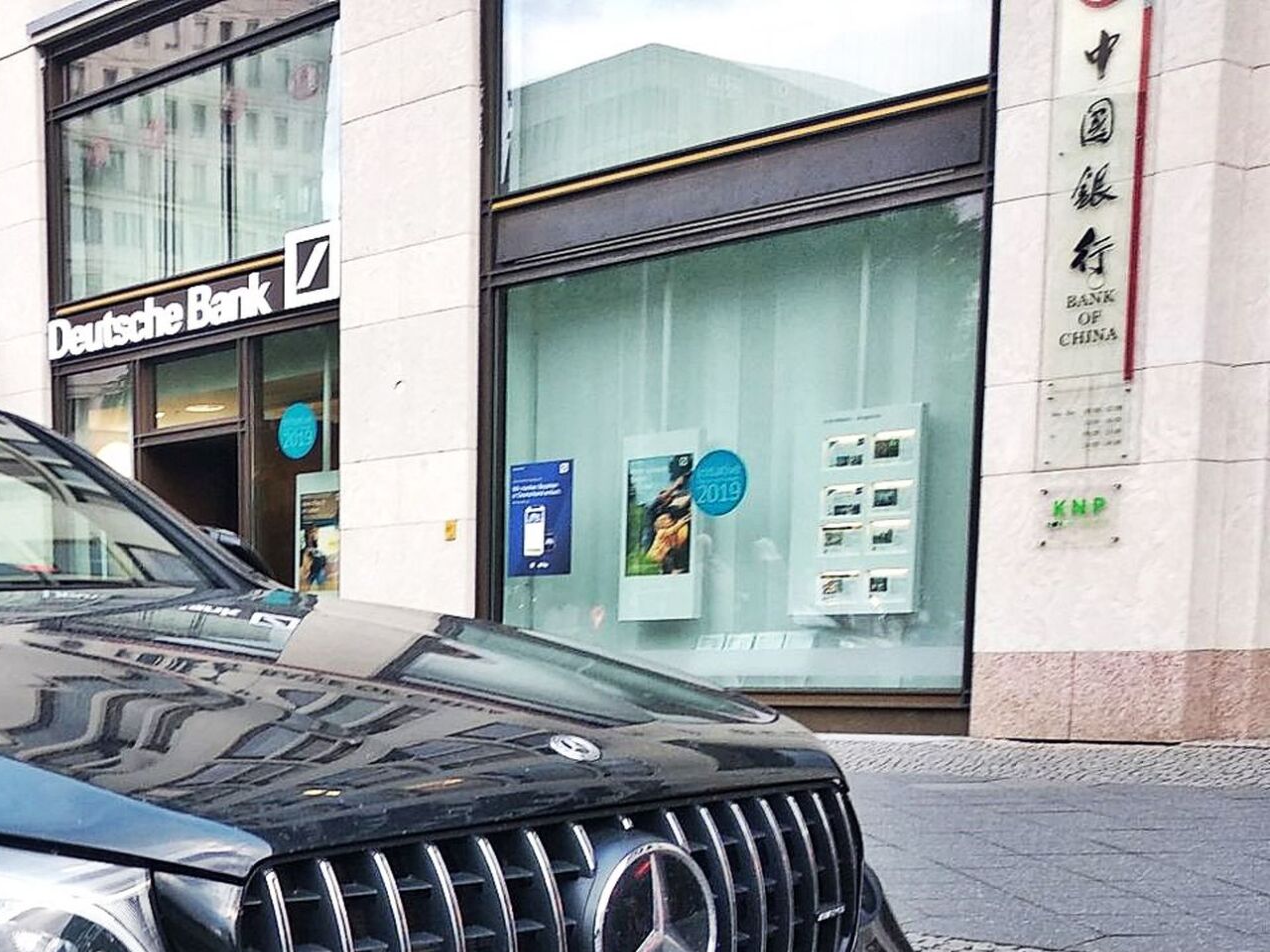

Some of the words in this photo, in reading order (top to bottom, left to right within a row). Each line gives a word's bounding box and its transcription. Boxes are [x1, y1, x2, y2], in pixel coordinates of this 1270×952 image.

[1066, 289, 1116, 308] BANK
[48, 296, 184, 361] Deutsche
[186, 272, 273, 329] Bank
[1078, 310, 1103, 326] OF
[1058, 327, 1119, 347] CHINA
[697, 482, 742, 504] 2019
